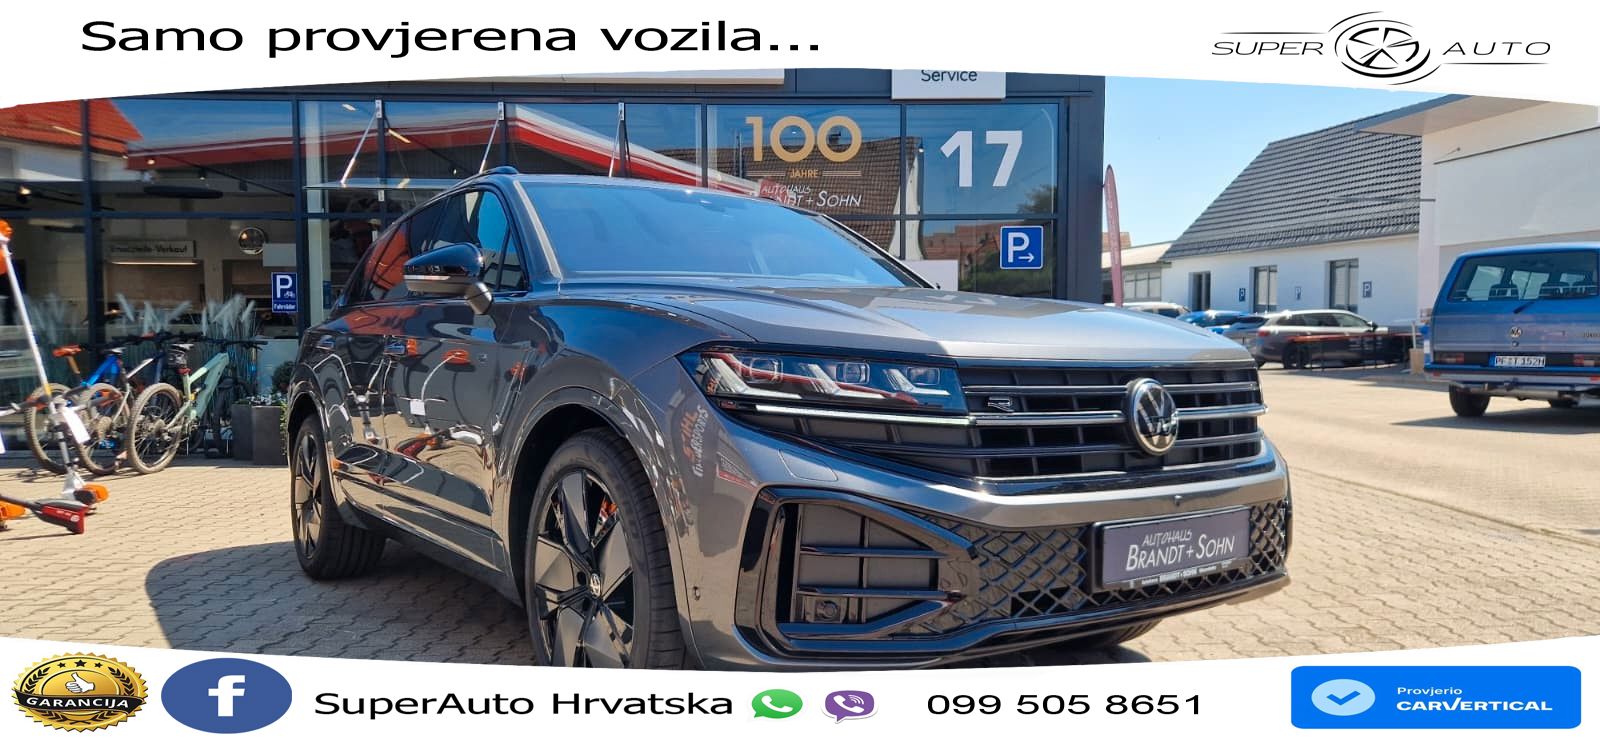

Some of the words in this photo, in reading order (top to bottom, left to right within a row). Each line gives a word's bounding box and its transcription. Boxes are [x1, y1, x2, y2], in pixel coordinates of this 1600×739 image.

[920, 69, 978, 82] Service
[745, 115, 862, 163] 100
[940, 129, 1023, 188] 17
[789, 169, 819, 178] JAHRE
[816, 190, 862, 207] SOHN
[1007, 231, 1030, 263] P
[276, 274, 293, 299] P
[1141, 528, 1193, 548] AUTOHAUS
[1125, 544, 1185, 572] BRANDT
[1195, 533, 1236, 560] SOHN
